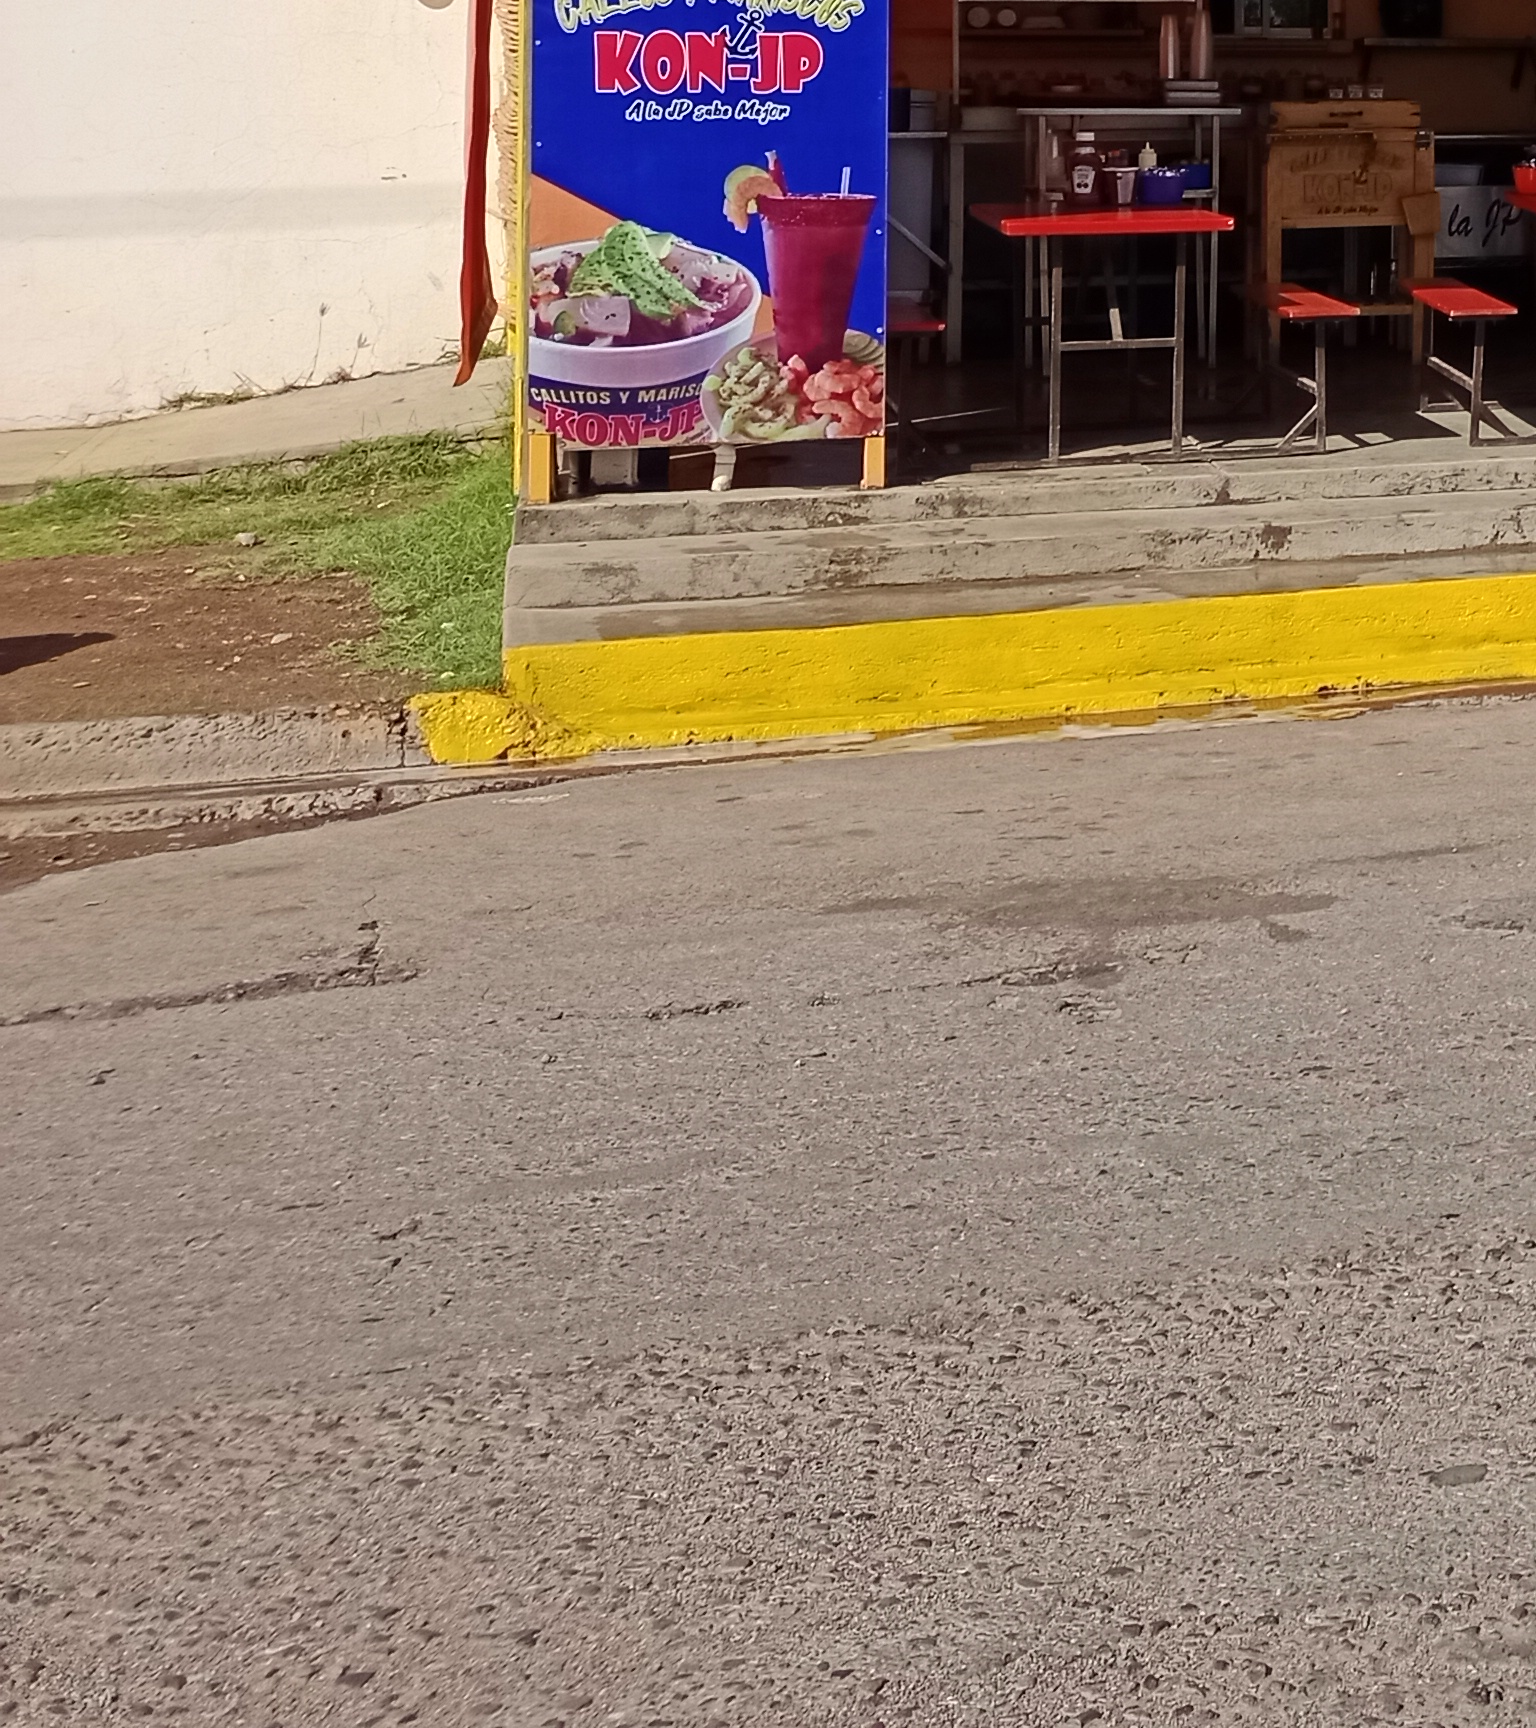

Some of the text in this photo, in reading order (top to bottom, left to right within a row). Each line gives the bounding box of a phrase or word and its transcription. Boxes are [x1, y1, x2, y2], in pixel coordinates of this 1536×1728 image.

[594, 29, 824, 96] KON-JP
[625, 99, 790, 125] A la JP sabe Mejor
[1448, 204, 1472, 237] la
[530, 386, 611, 405] CALLITOS
[619, 390, 630, 404] Y
[543, 399, 703, 447] KON-JP
